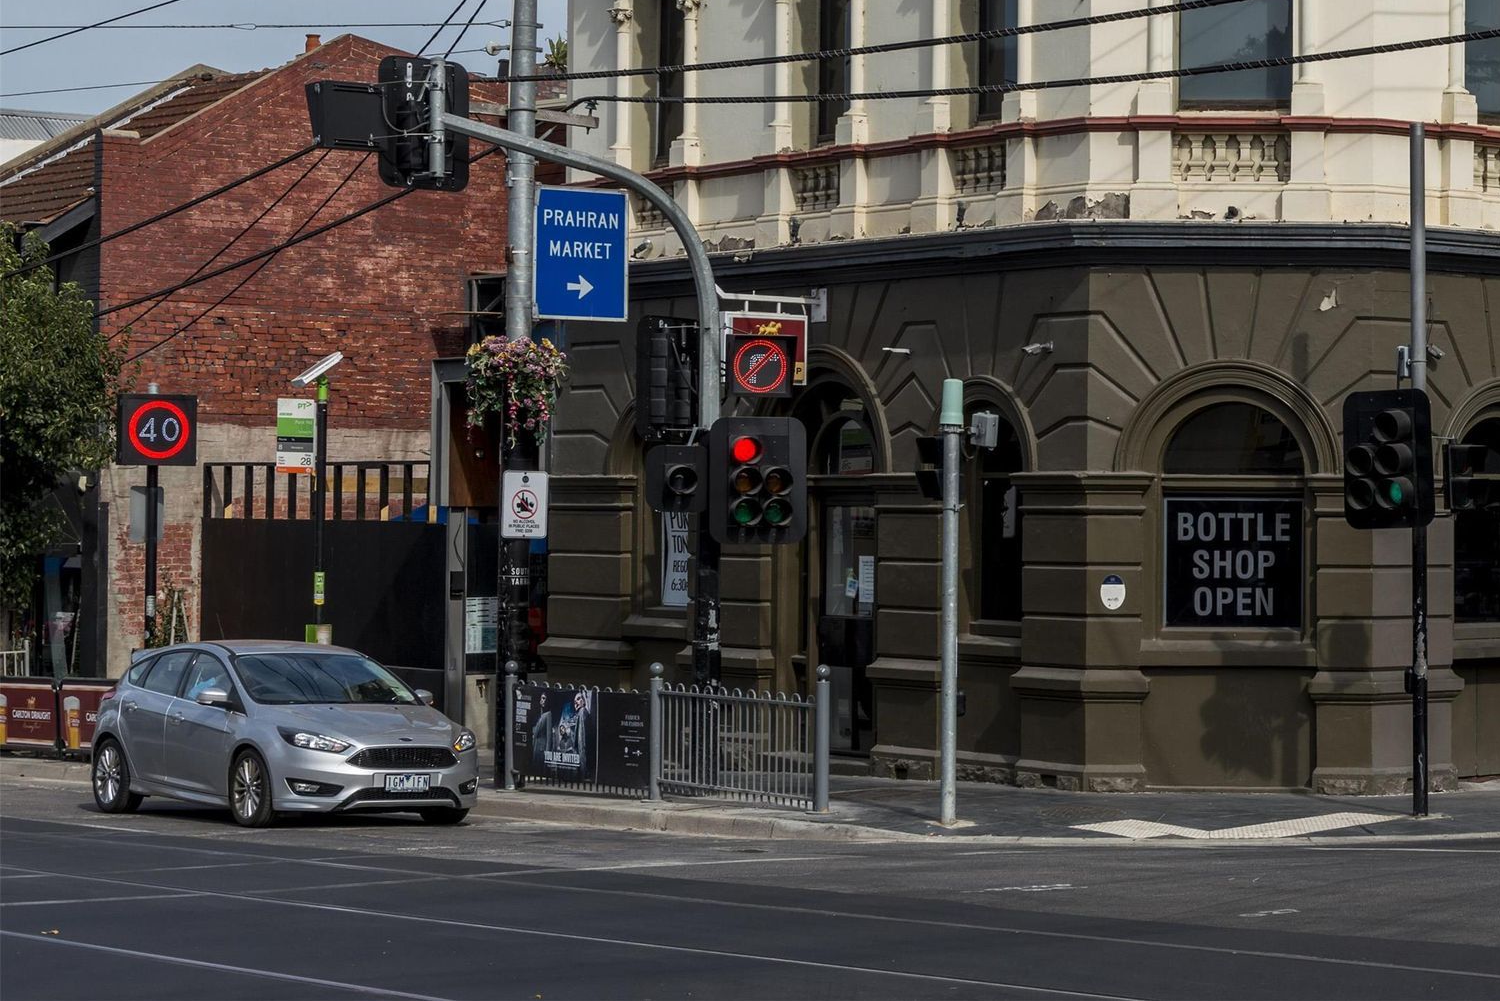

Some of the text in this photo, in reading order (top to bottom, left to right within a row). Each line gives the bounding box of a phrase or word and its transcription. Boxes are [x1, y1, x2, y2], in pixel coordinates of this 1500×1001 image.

[543, 208, 619, 230] PRAHRAN
[549, 240, 612, 260] MARKET
[138, 417, 180, 442] 40
[300, 457, 312, 466] 28
[1177, 512, 1291, 542] BOTTLE
[1192, 549, 1276, 579] SHOP
[1193, 586, 1274, 616] OPEN
[12, 709, 51, 719] CARLTON DRAUGHT
[544, 751, 580, 763] YOU ARE INVITED
